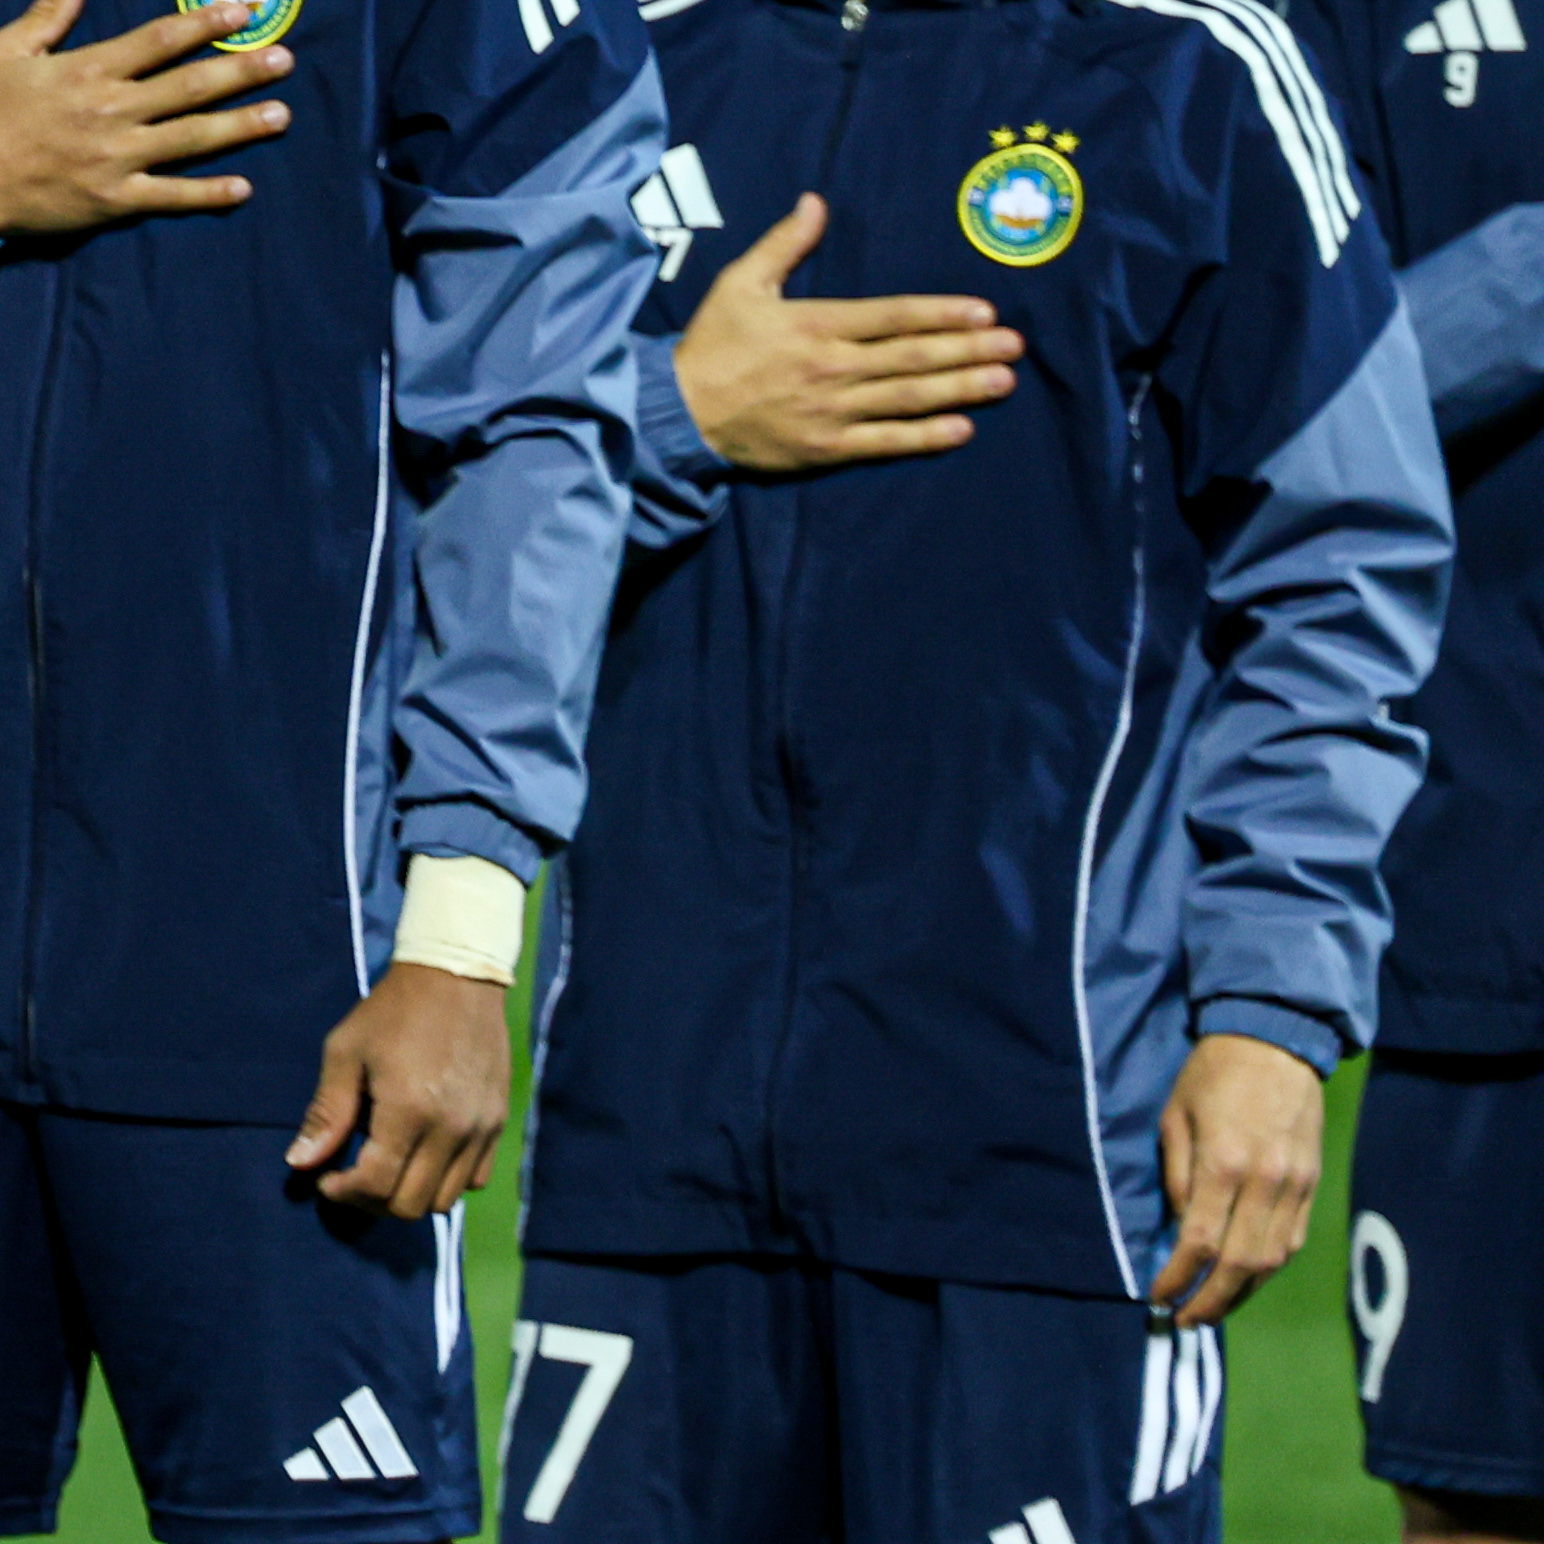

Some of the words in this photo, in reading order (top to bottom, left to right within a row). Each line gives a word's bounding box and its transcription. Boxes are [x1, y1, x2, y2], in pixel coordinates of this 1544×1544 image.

[1443, 51, 1479, 108] 9
[643, 227, 694, 282] 7
[1351, 1209, 1409, 1403] 9
